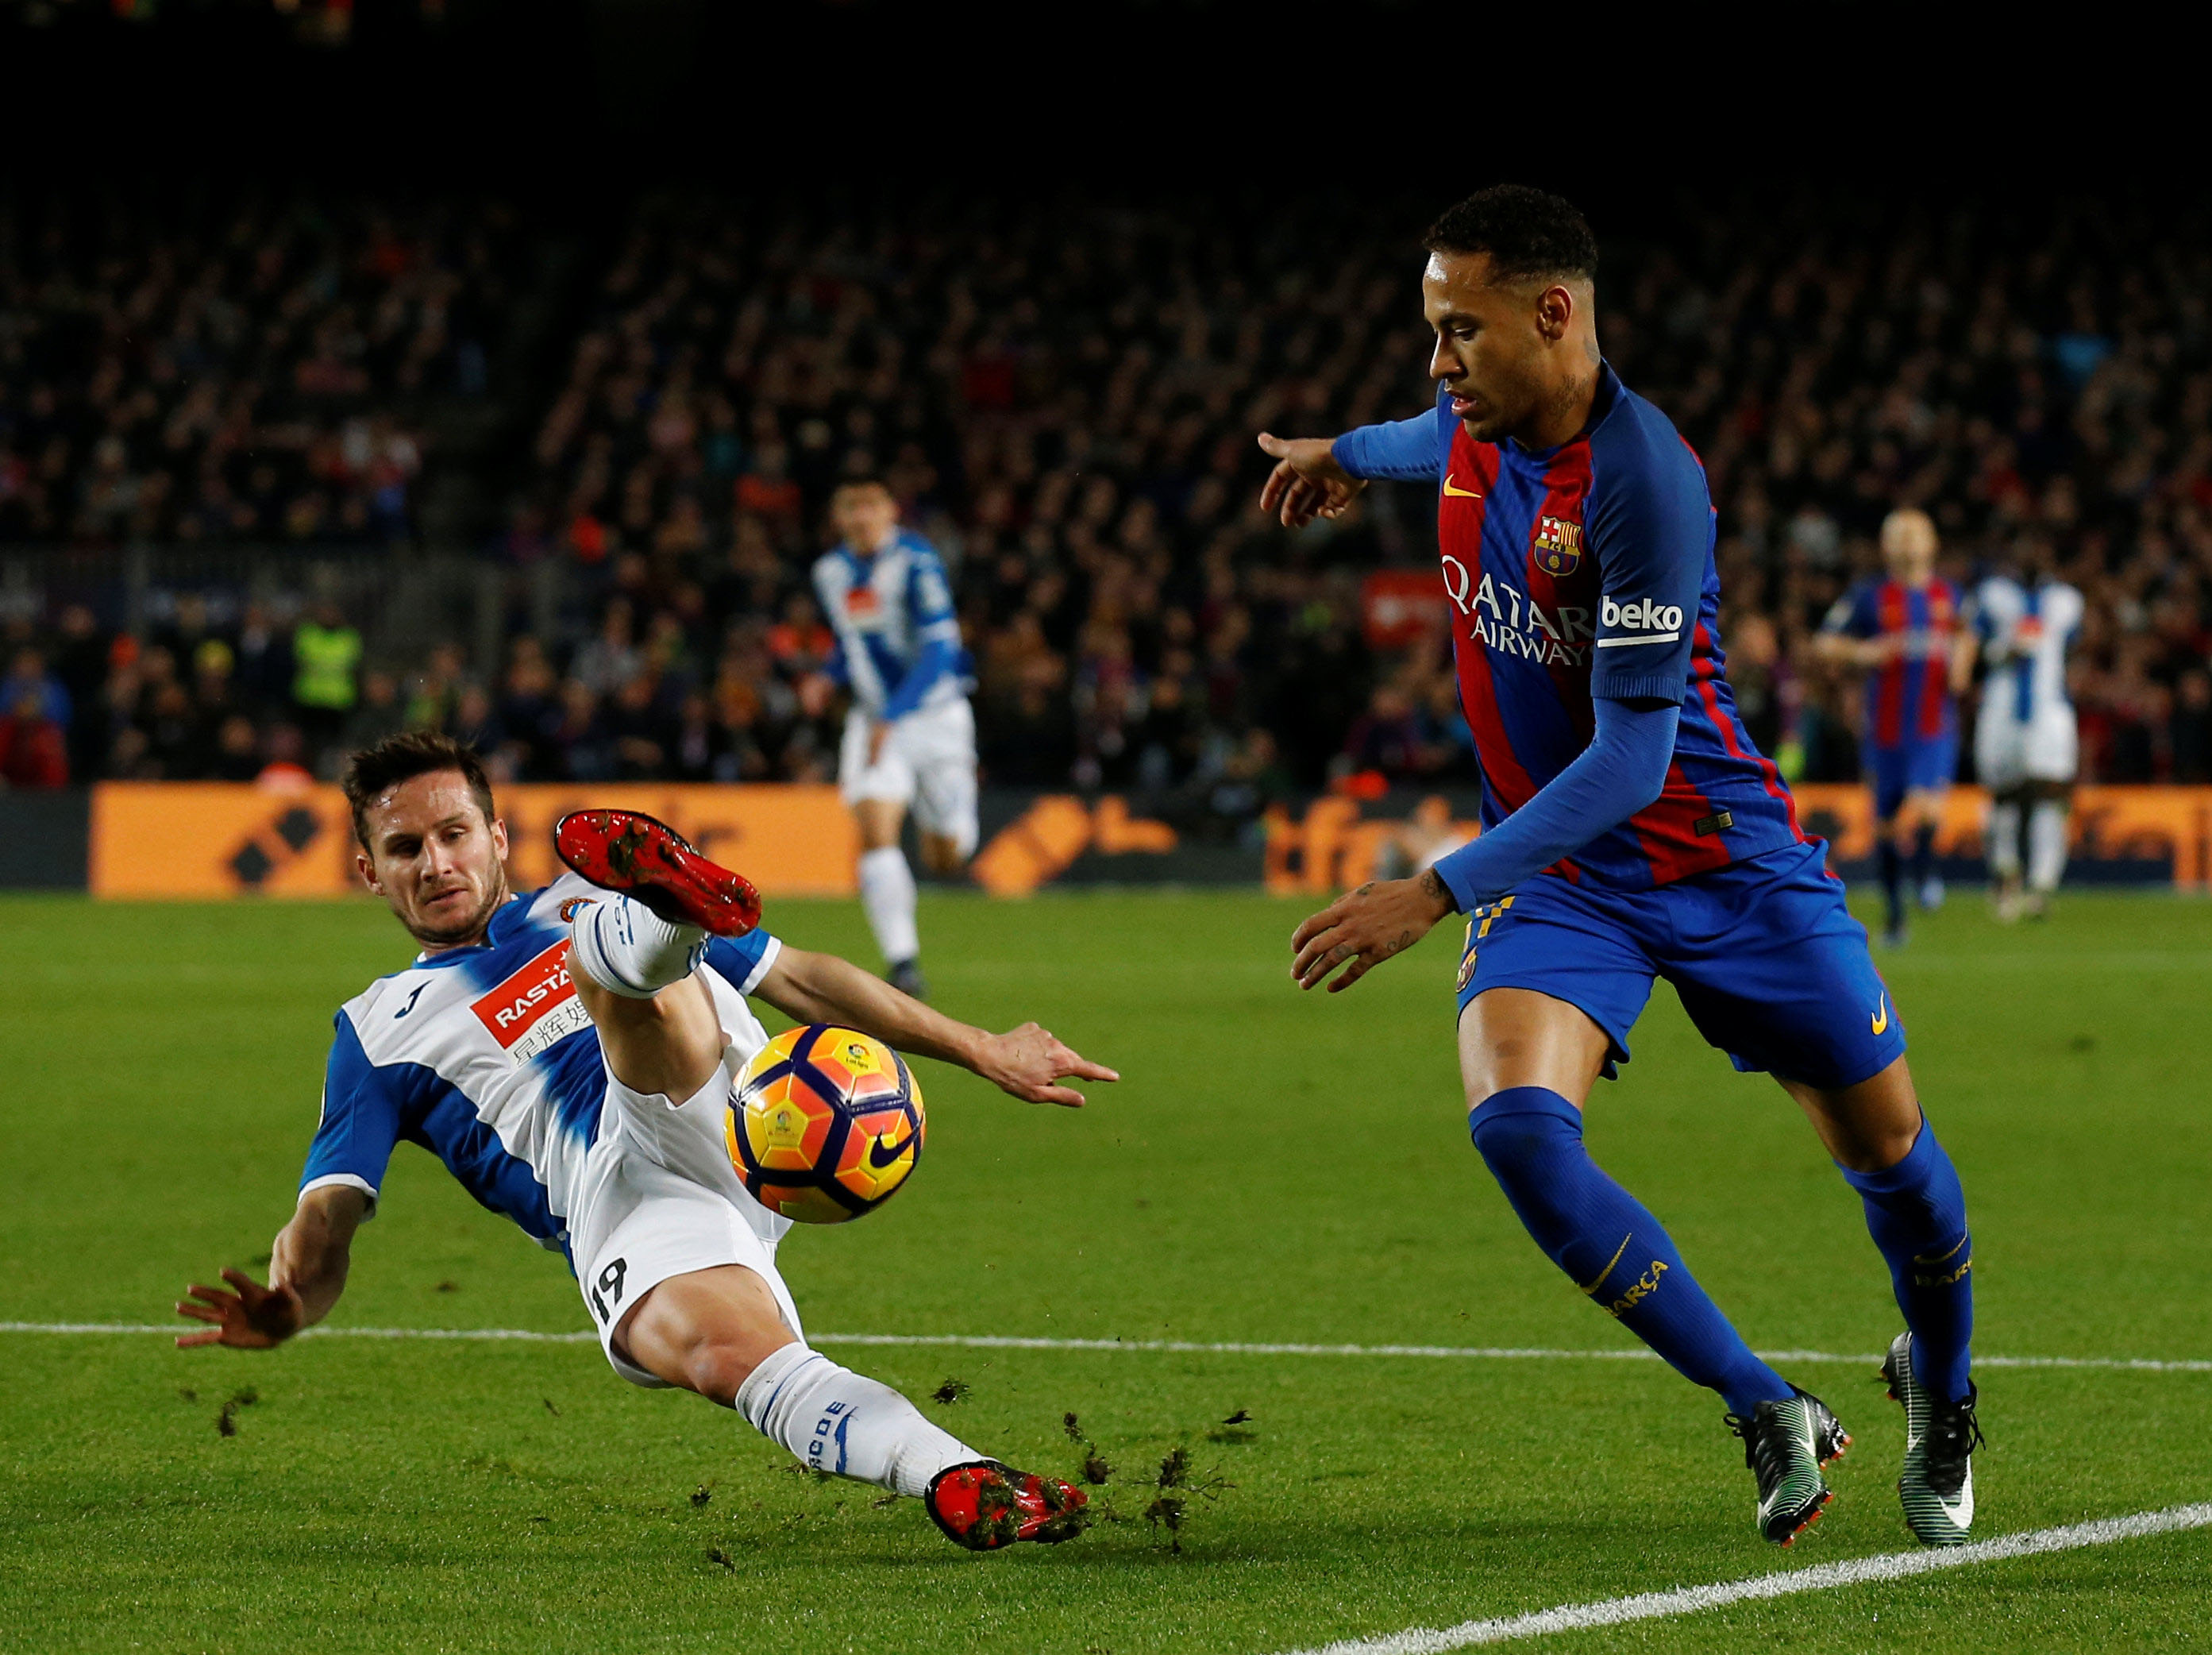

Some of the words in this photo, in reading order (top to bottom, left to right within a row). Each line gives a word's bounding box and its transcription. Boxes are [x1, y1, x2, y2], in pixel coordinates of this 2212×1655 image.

[1442, 554, 1596, 642] QATAR
[1601, 596, 1682, 631] beko
[1470, 615, 1594, 666] AIRWAY
[592, 1257, 628, 1325] 19
